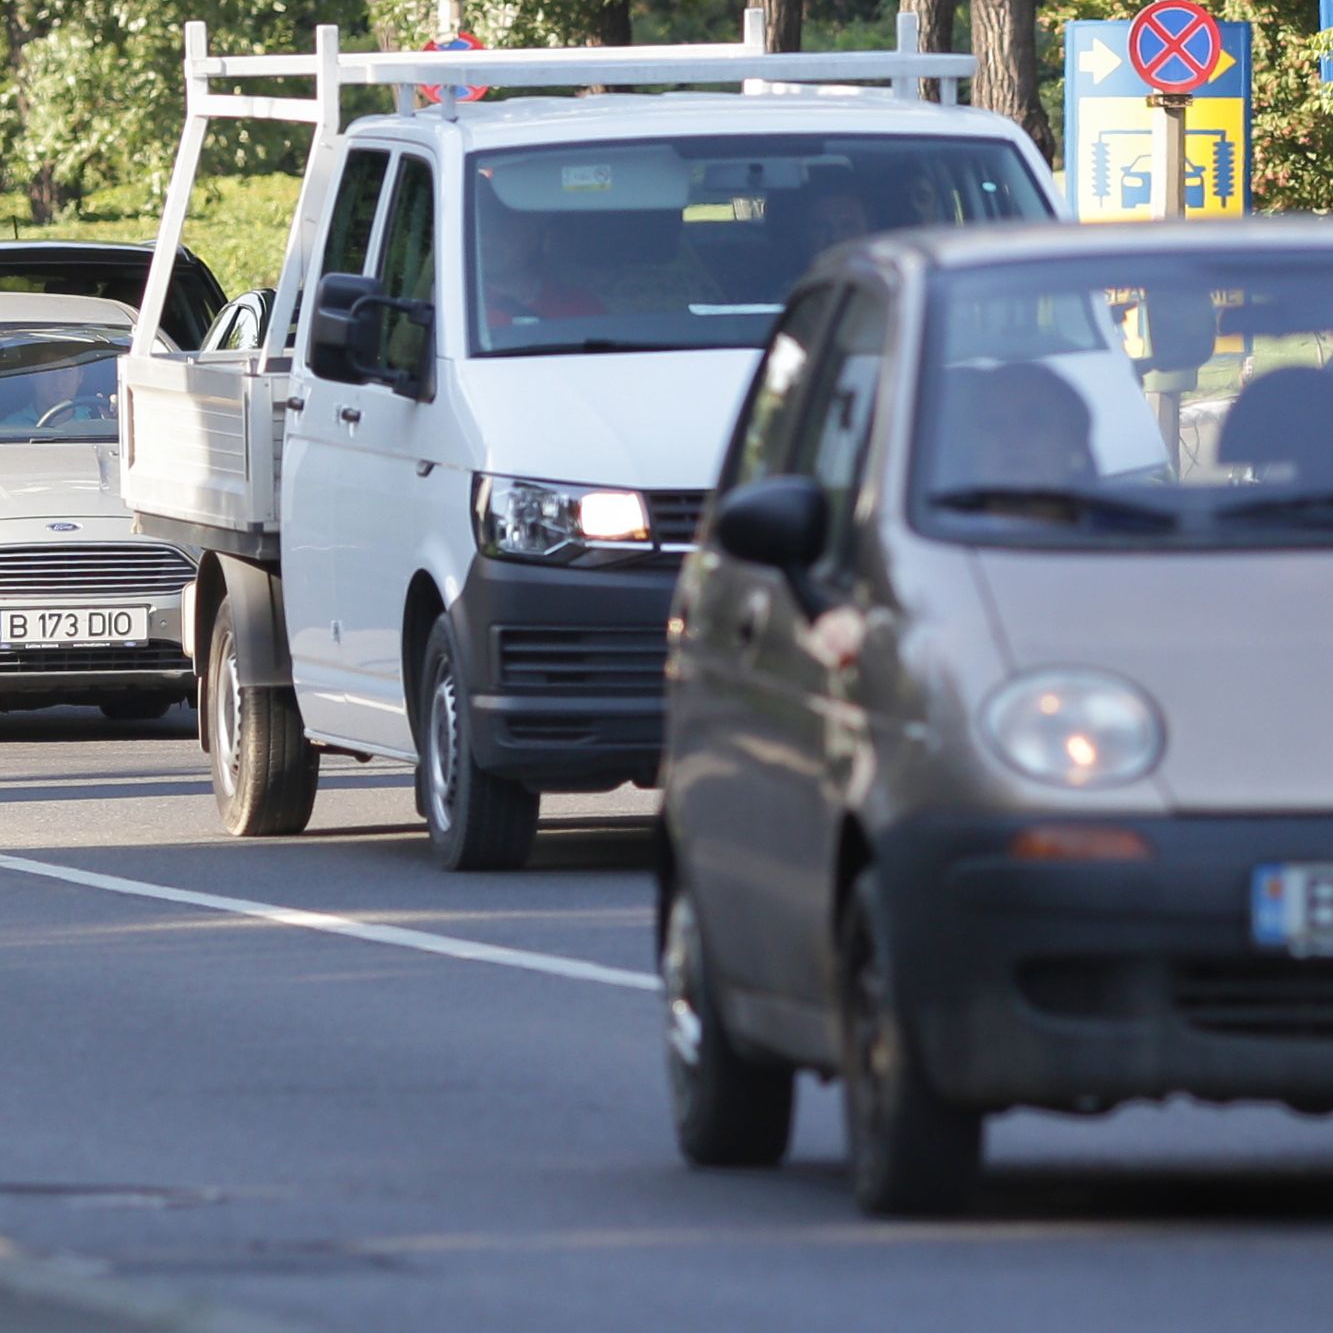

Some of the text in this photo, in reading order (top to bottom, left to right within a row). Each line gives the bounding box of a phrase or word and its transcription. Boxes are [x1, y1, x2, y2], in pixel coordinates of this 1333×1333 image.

[9, 612, 132, 639] B 173 DIO
